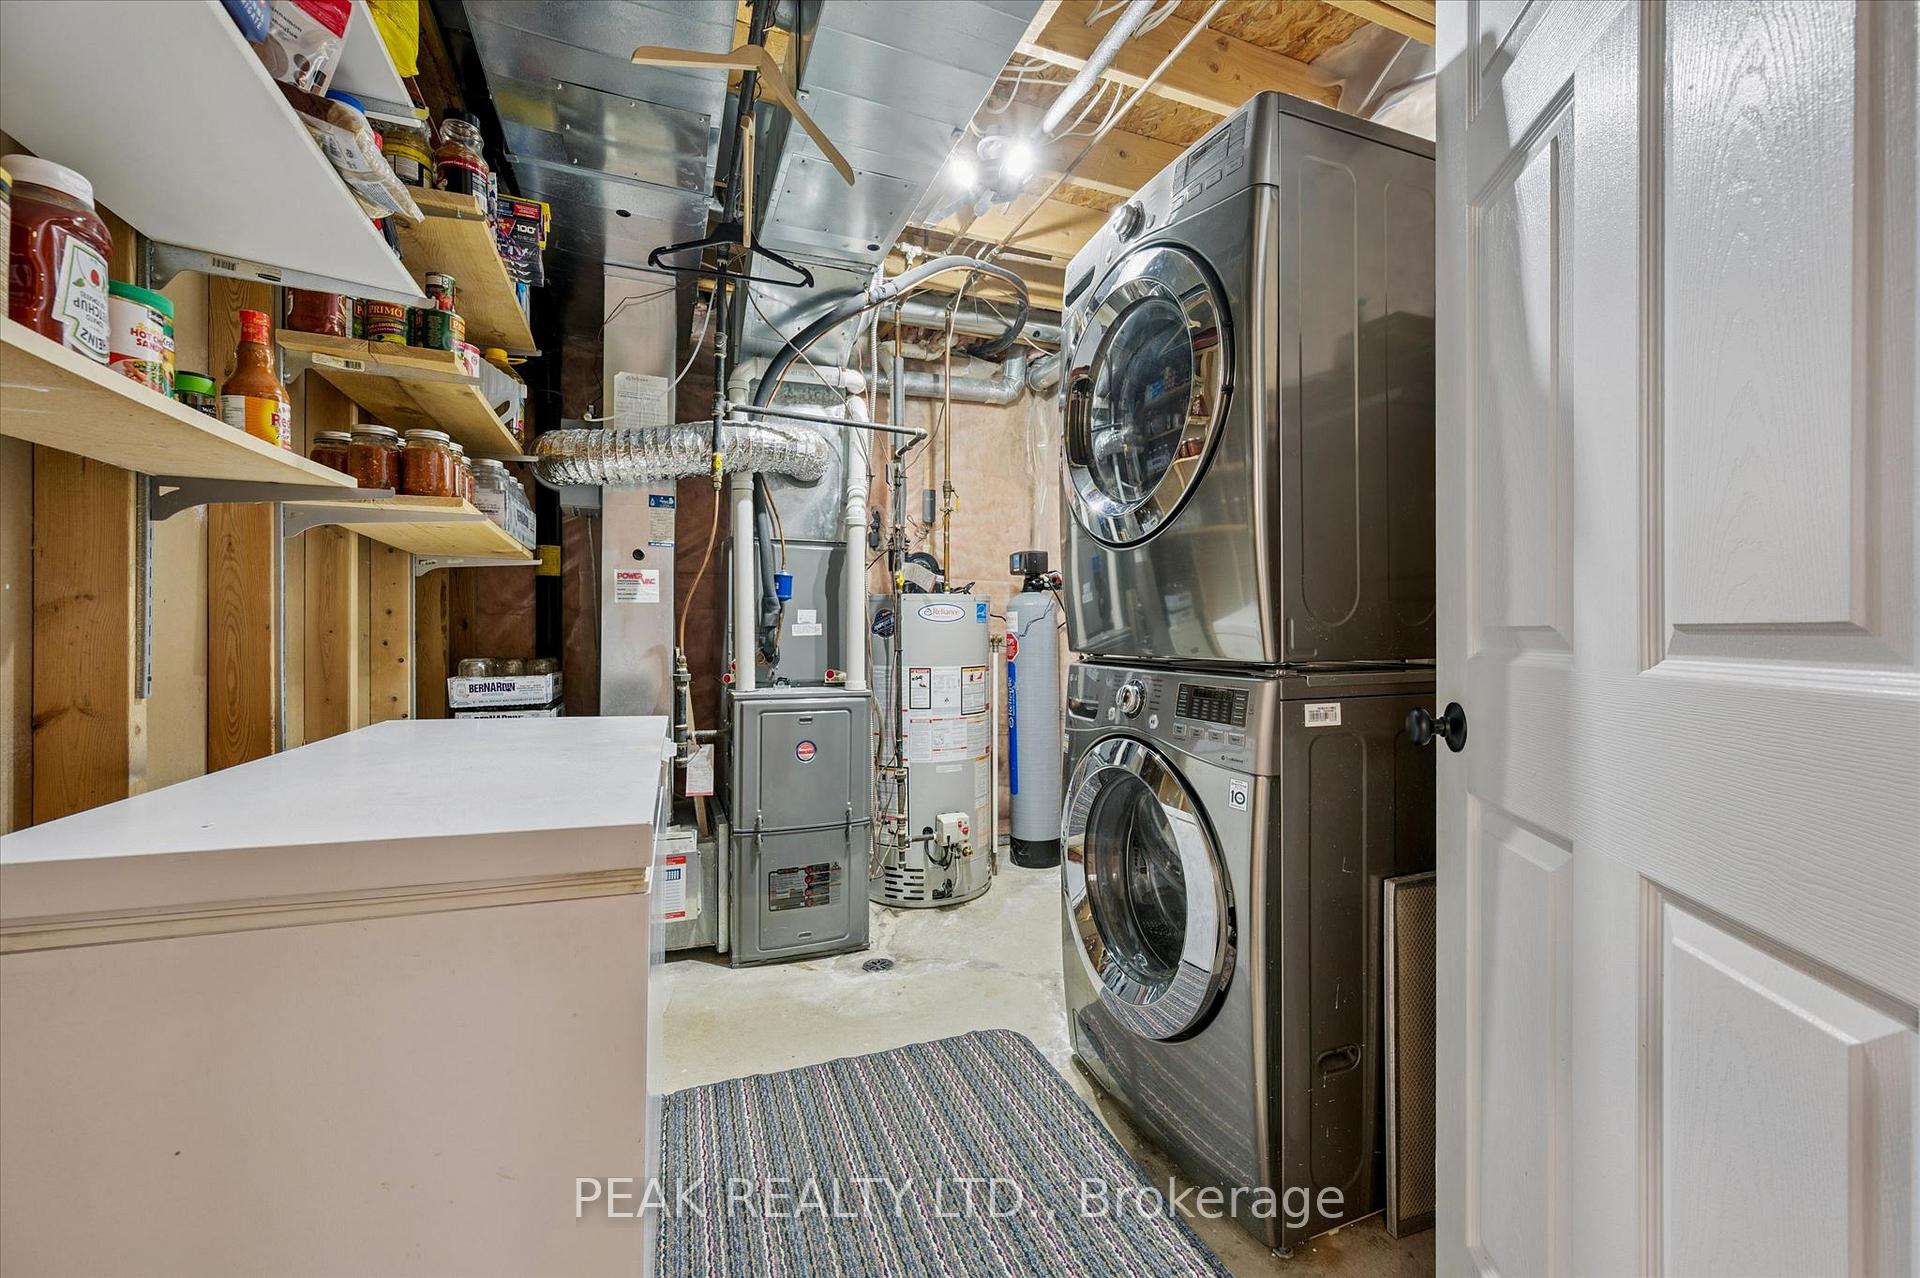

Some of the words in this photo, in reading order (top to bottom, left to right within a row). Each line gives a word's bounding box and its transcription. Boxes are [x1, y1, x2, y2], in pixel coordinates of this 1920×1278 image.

[73, 298, 106, 319] ETCHUP
[368, 304, 403, 317] PRIMO
[130, 327, 151, 340] HOT
[617, 572, 643, 580] POWER
[933, 607, 960, 617] Reliance
[469, 682, 516, 694] BERNARDIN
[1231, 790, 1246, 805] 10
